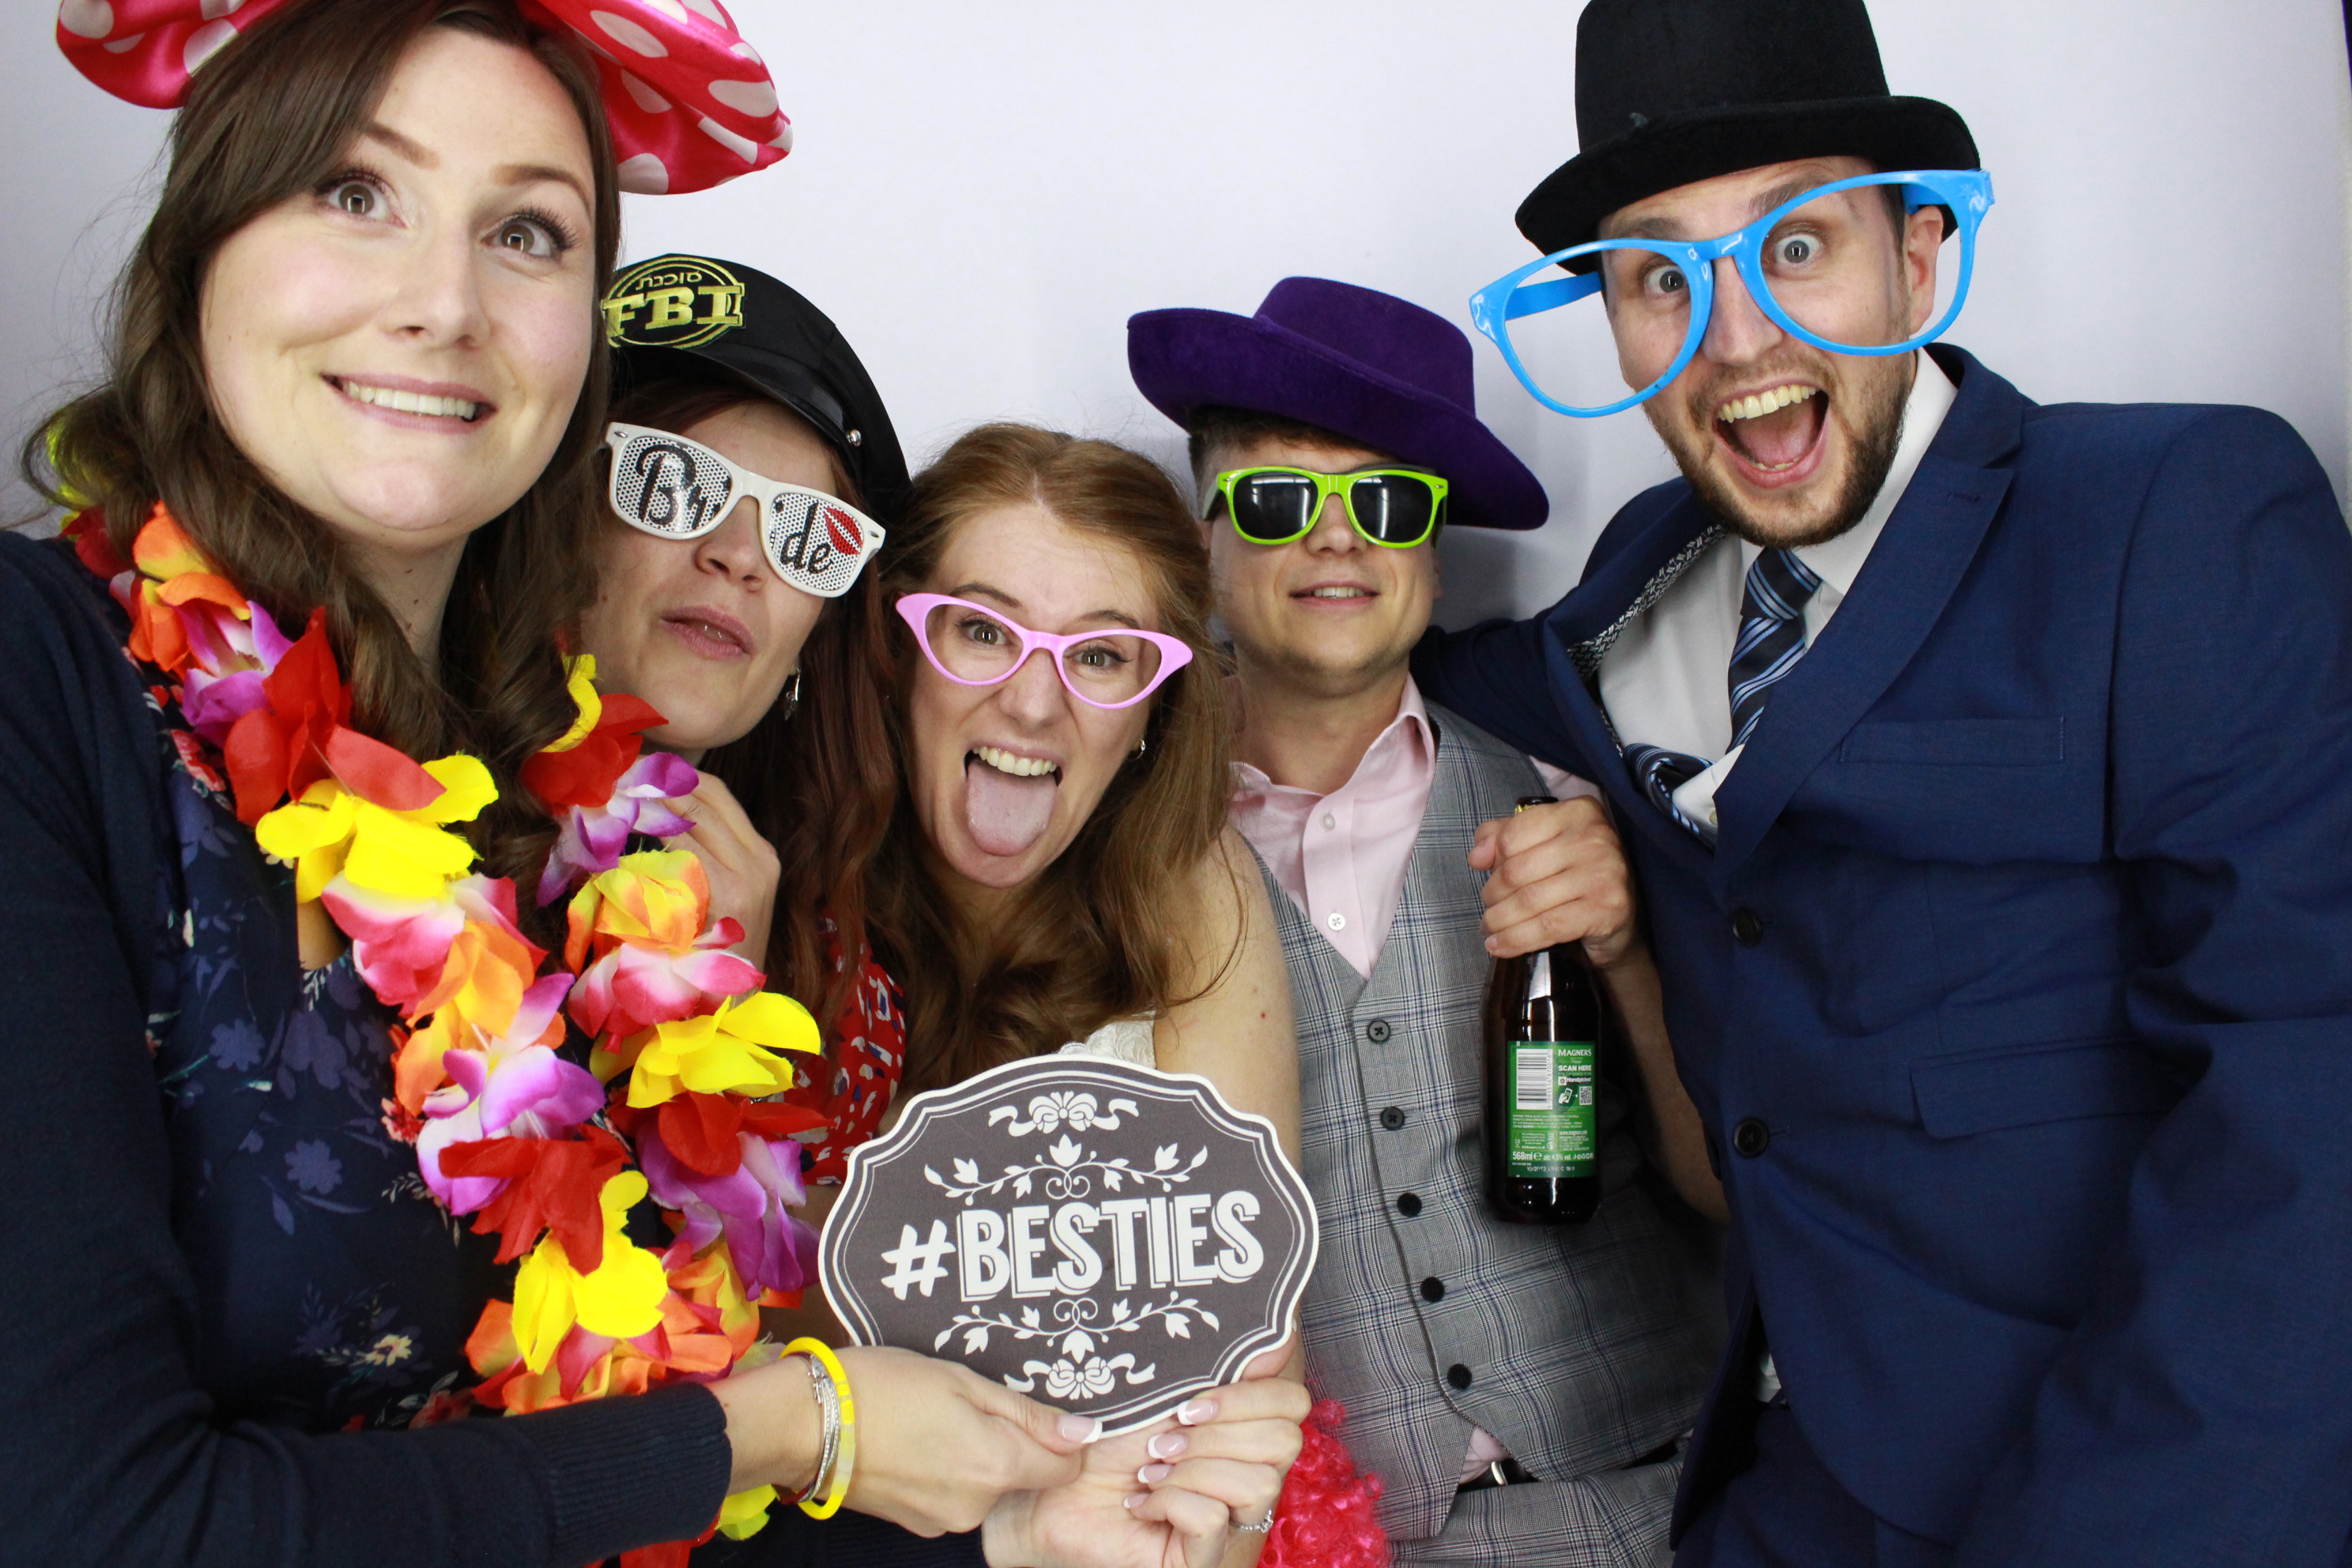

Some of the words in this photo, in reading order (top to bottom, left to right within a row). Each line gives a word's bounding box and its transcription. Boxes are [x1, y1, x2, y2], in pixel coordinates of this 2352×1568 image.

[636, 271, 703, 291] סוכנת
[602, 284, 745, 338] FBI
[1512, 1151, 1533, 1160] 568ml
[881, 1190, 1264, 1302] #BESTIES
